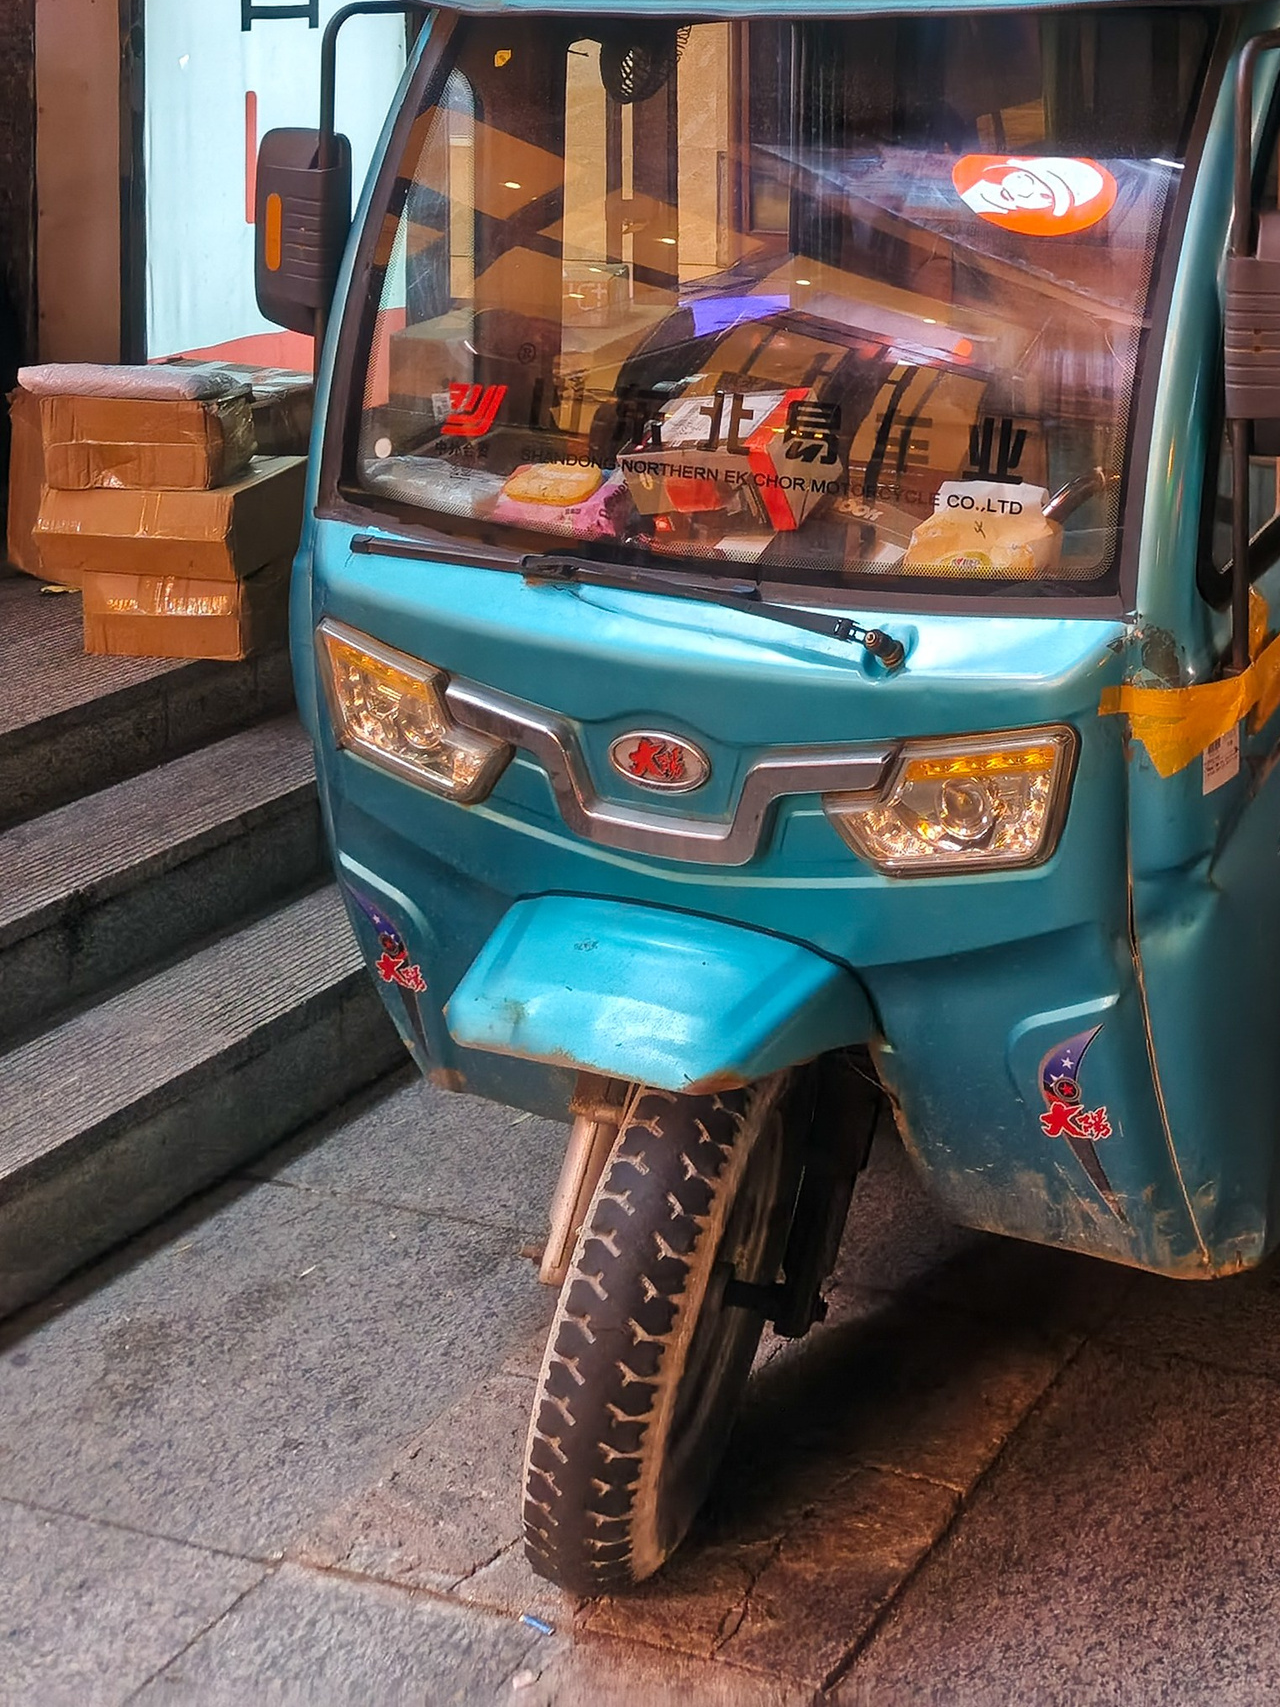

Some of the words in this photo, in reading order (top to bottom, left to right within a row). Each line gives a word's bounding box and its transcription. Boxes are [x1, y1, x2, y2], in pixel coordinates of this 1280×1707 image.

[521, 447, 616, 471] SHANDONG
[621, 459, 718, 482] NORTHERN
[753, 472, 805, 492] CHOR
[946, 493, 1024, 515] CO.,LTD
